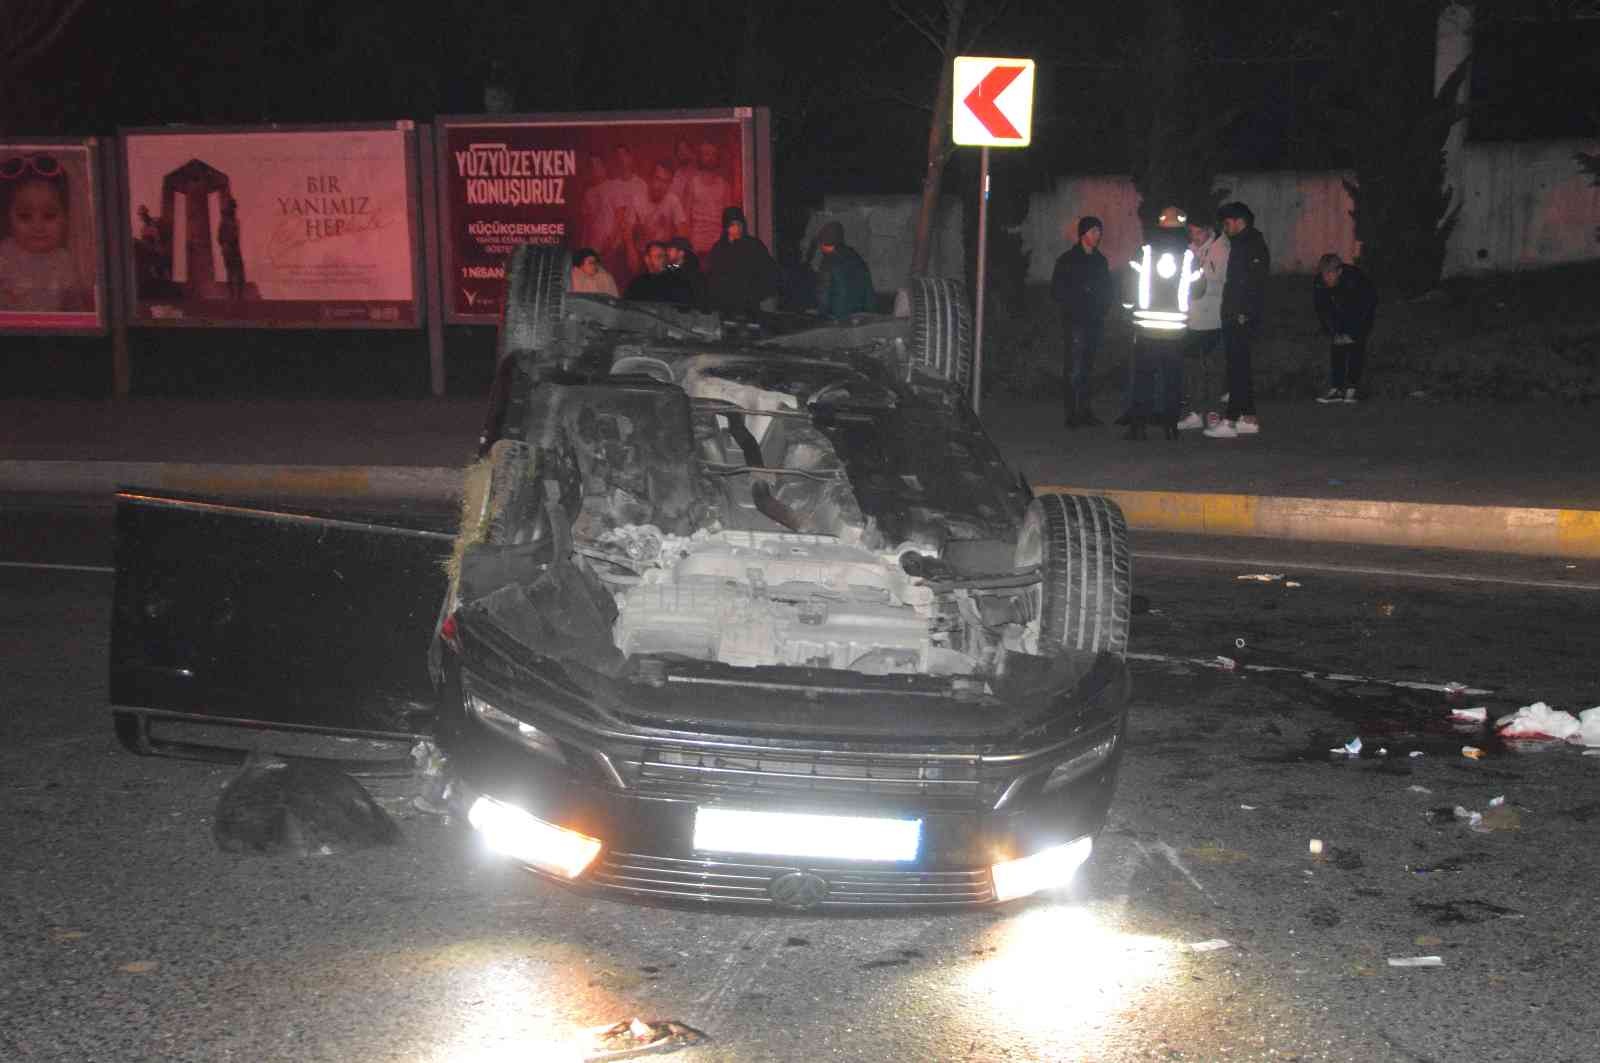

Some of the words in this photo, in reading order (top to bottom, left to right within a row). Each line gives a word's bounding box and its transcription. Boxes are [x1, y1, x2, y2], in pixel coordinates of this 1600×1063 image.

[467, 178, 565, 206] KONUŞURUZ
[277, 196, 369, 215] YANIMIZ
[305, 218, 344, 237] HEP
[468, 220, 565, 235] KÜÇÜKÇEKMECE
